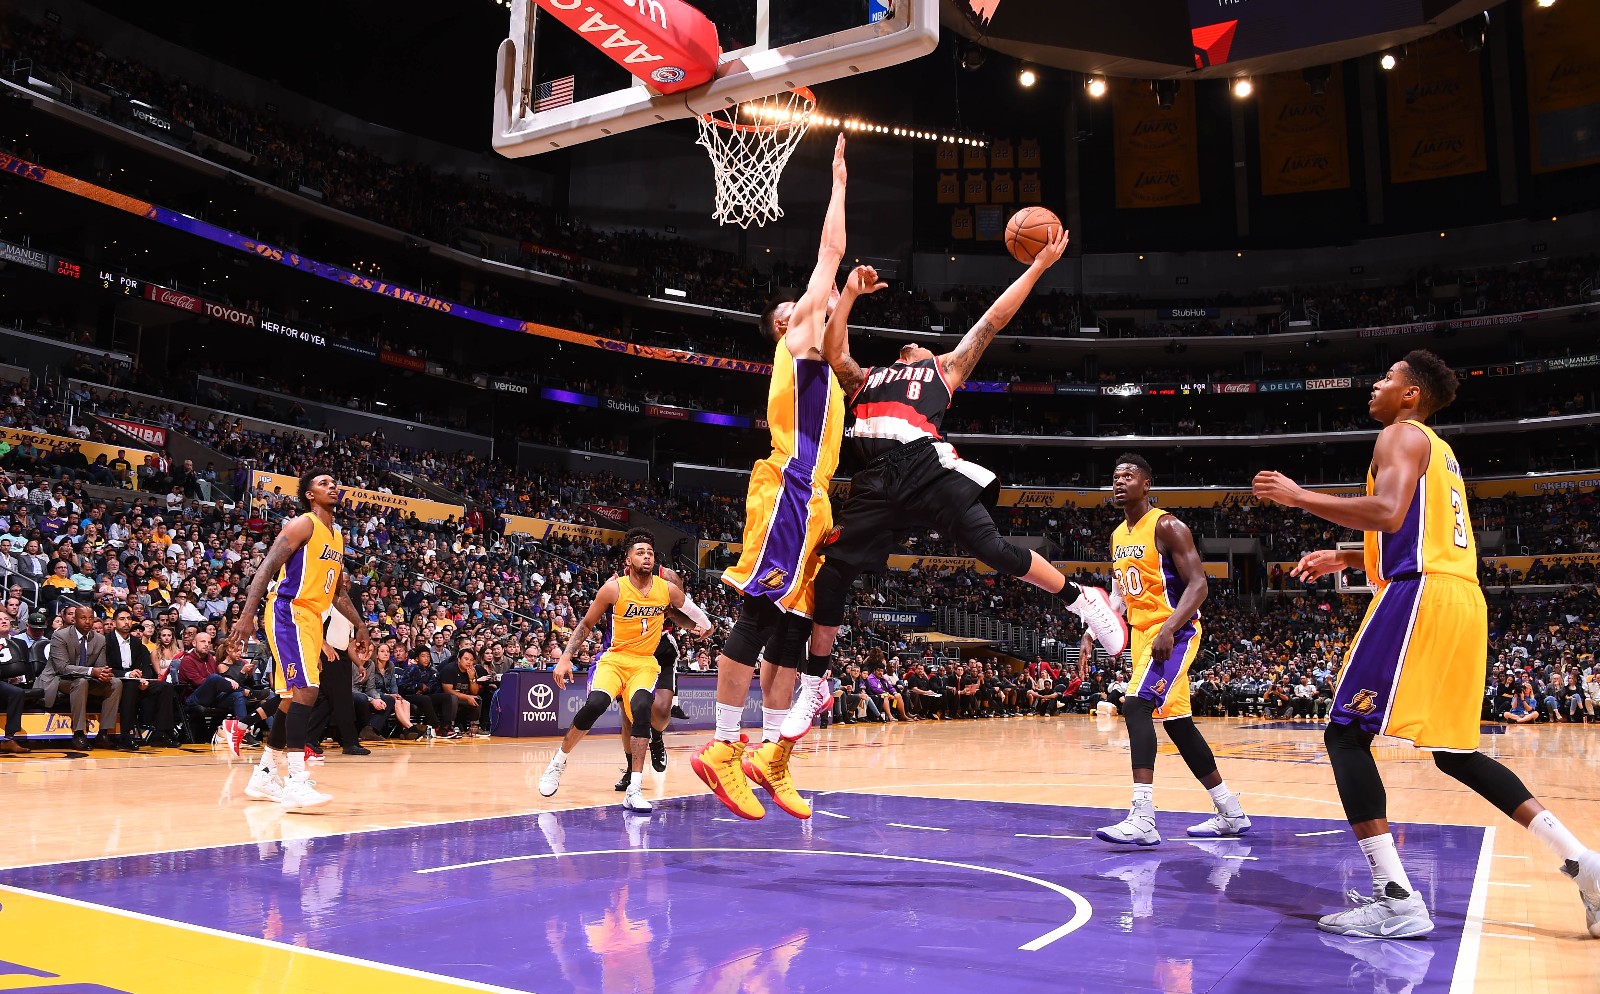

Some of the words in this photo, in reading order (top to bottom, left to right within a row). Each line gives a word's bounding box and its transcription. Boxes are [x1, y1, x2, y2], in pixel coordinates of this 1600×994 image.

[132, 108, 170, 129] verizon
[5, 244, 46, 263] MANUEL
[57, 267, 80, 279] OUTS
[58, 261, 80, 272] TIME
[100, 271, 114, 282] LAL
[120, 277, 138, 288] POR
[124, 286, 130, 295] 2
[376, 283, 453, 313] LAKERS
[205, 303, 255, 327] TOYOTA
[1172, 308, 1206, 318] StubHub
[261, 320, 279, 333] HER
[280, 325, 298, 338] FOR
[299, 330, 309, 342] 40
[310, 334, 326, 346] YEA
[494, 381, 528, 394] verizon
[863, 367, 934, 393] PORTLAND
[1271, 382, 1302, 391] DELTA
[1306, 378, 1350, 389] STAPLES
[906, 381, 922, 400] 8
[607, 400, 640, 413] StubHub
[352, 491, 368, 499] LOS
[369, 493, 408, 506] ANGELES
[1017, 491, 1054, 507] LAKERS
[1451, 486, 1467, 549] 3
[323, 568, 335, 594] 0
[1114, 566, 1143, 597] 30
[872, 613, 891, 622] BUD
[891, 614, 917, 623] LIGHT
[641, 617, 648, 636] 1
[522, 711, 557, 722] TOYOTA
